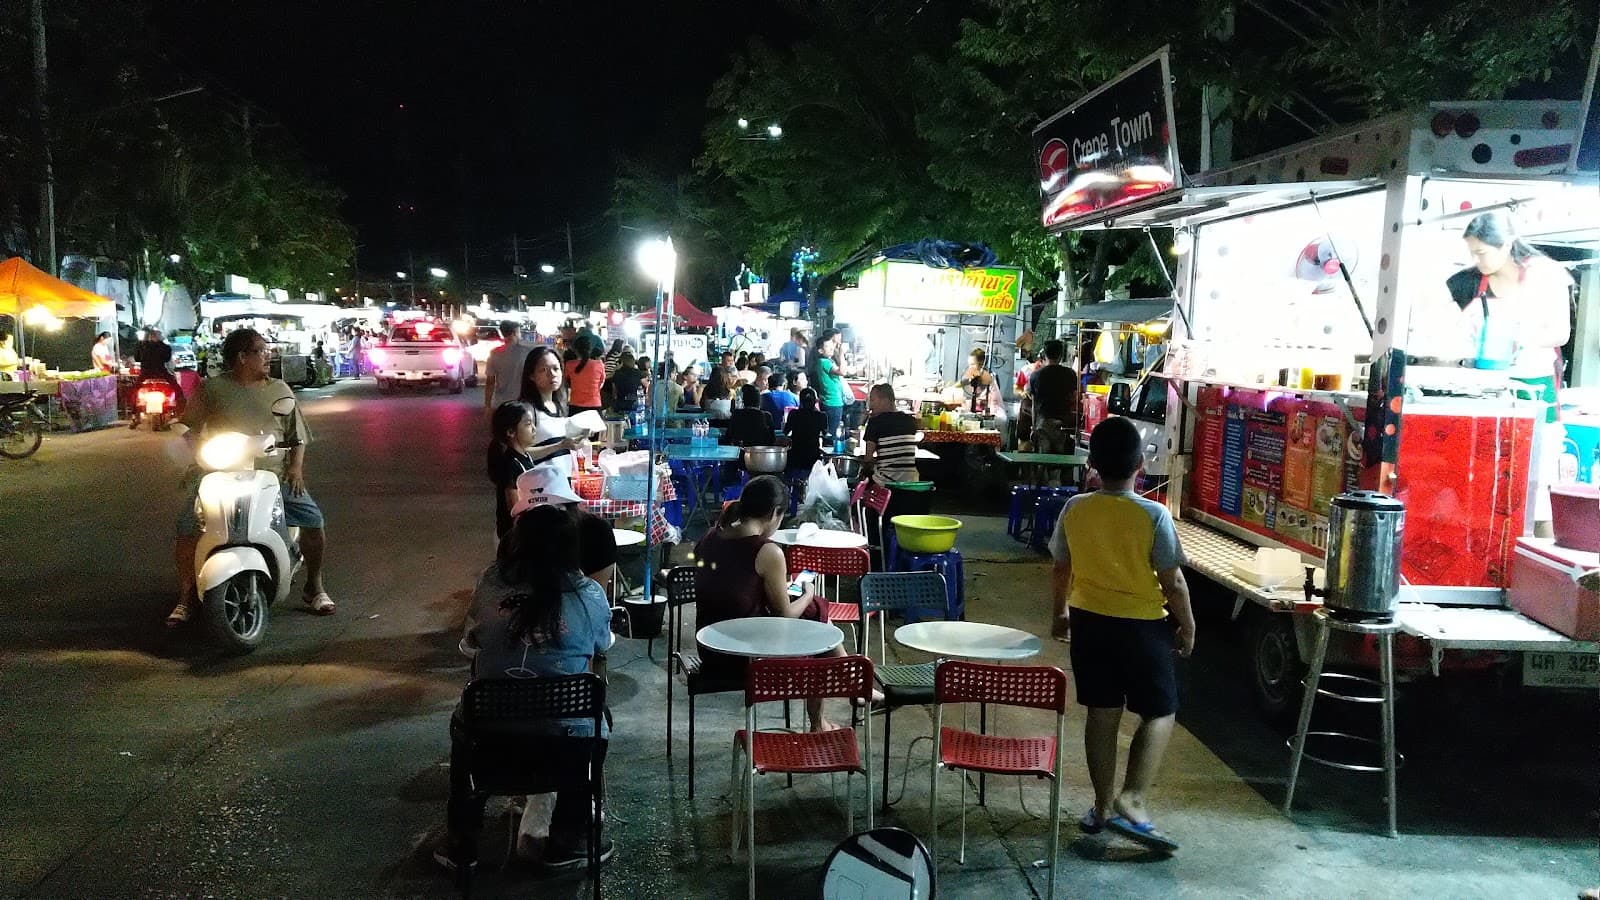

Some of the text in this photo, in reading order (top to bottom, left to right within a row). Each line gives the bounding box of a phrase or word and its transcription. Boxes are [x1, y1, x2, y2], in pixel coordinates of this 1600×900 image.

[1072, 111, 1153, 169] Crepe Town
[1003, 274, 1016, 291] 7
